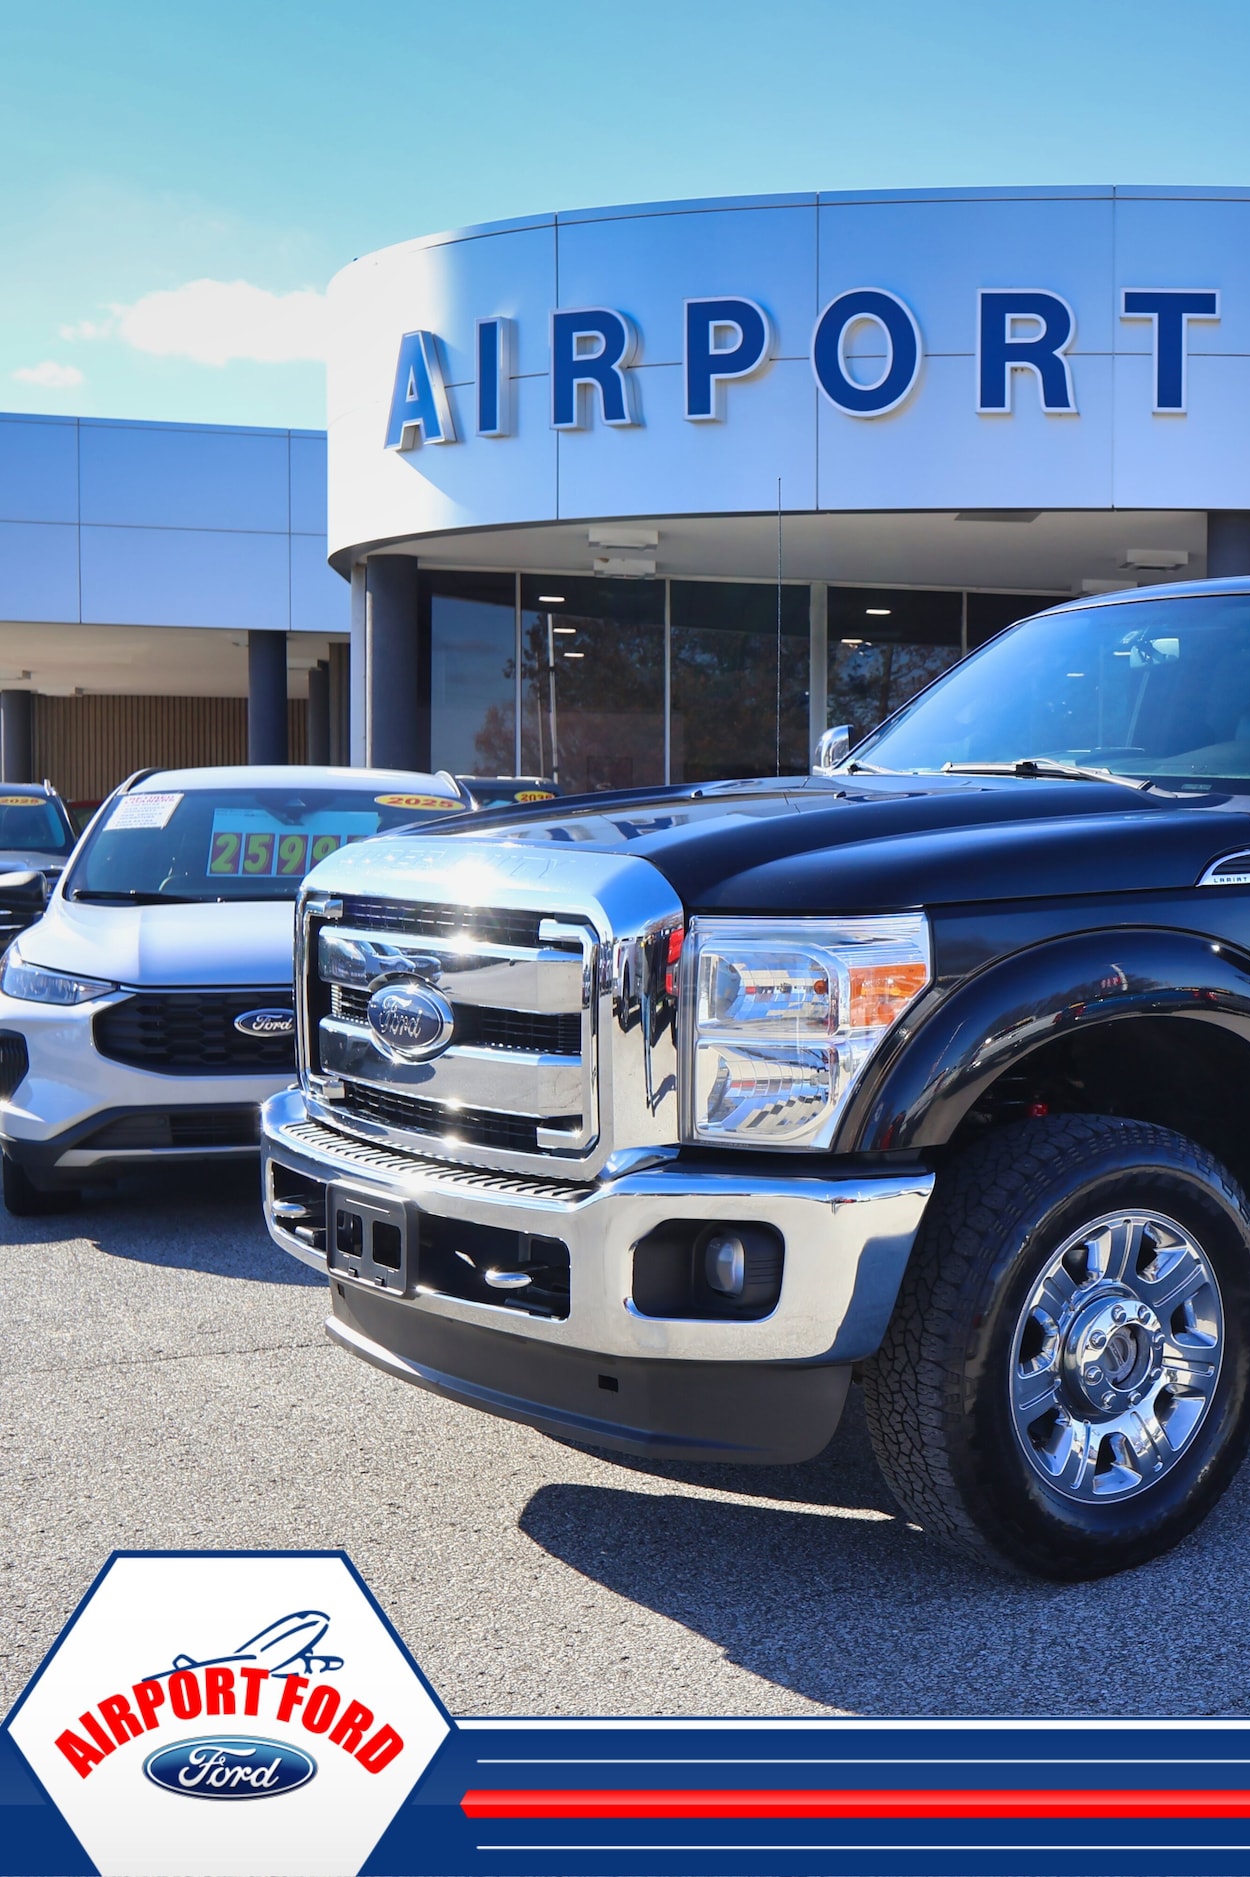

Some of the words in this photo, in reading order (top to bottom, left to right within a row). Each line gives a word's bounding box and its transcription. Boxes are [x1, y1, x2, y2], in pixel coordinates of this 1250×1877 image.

[384, 286, 1221, 452] AIRPORT
[387, 797, 454, 808] 2025
[211, 833, 366, 873] 2599
[1213, 876, 1248, 884] LARIAT
[252, 1014, 293, 1031] Ford
[380, 995, 421, 1039] Ford
